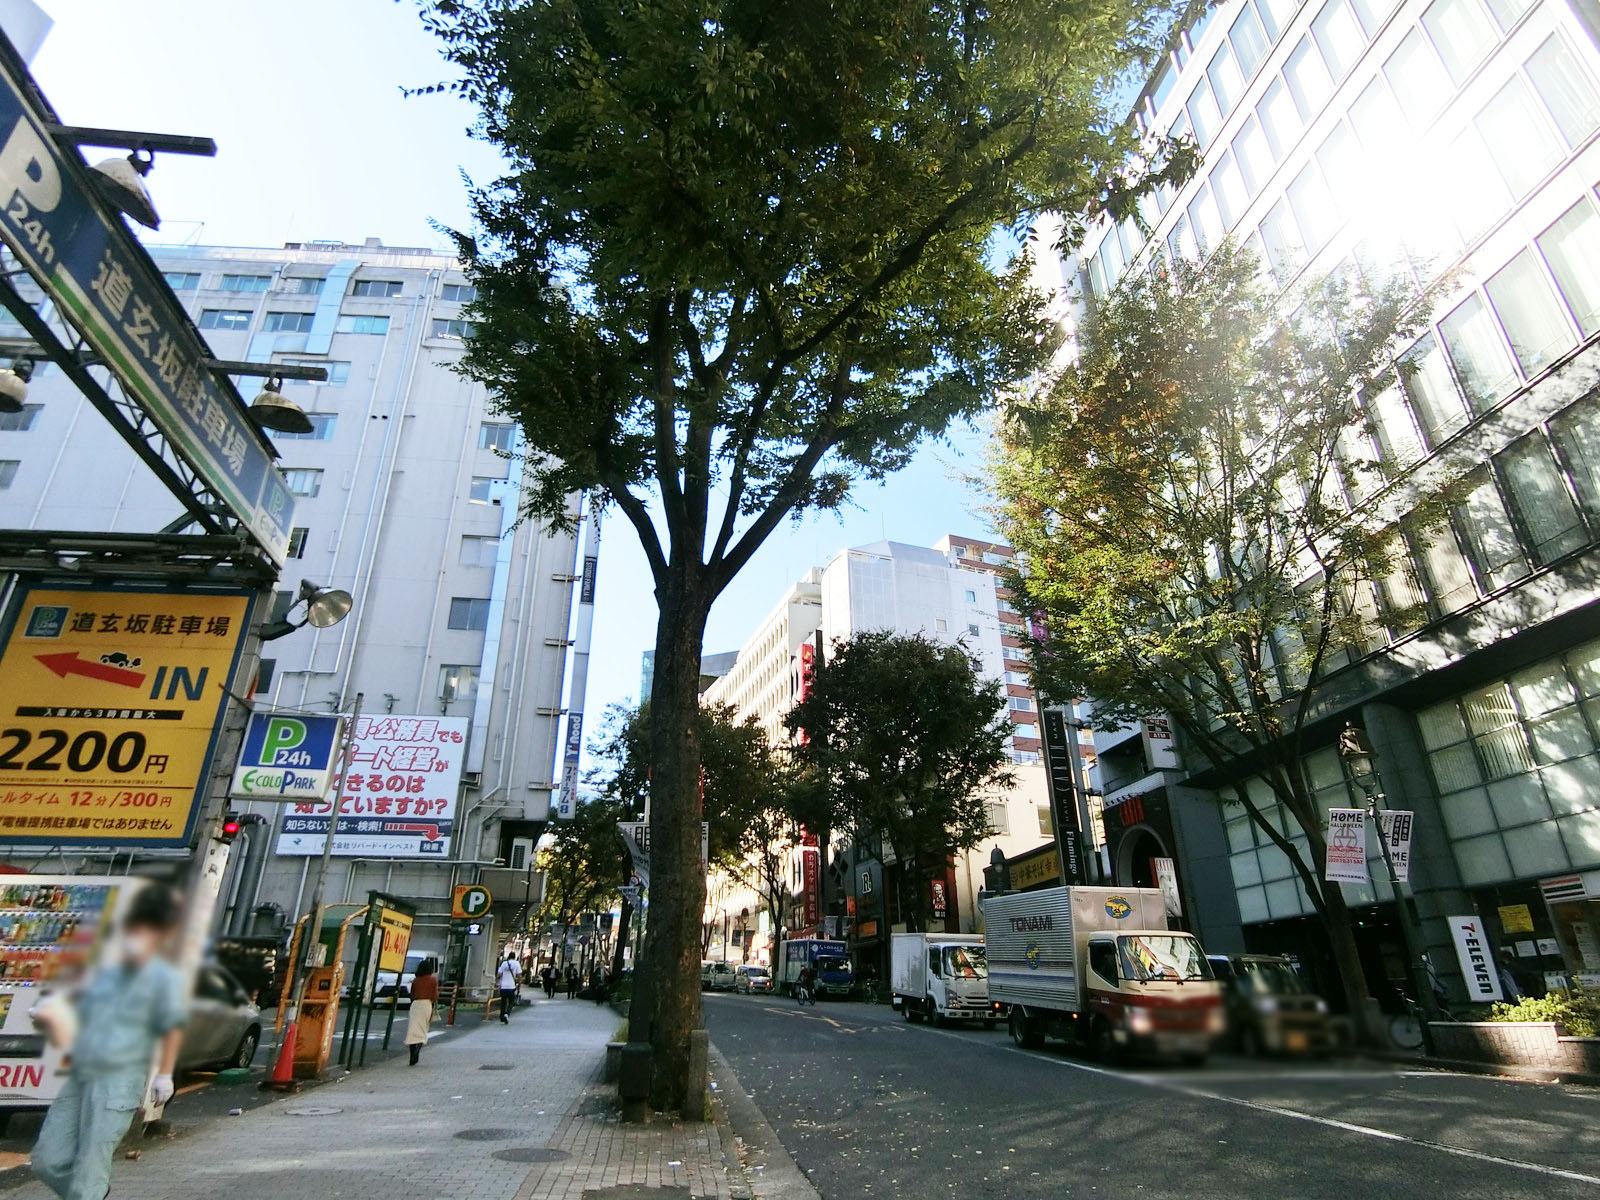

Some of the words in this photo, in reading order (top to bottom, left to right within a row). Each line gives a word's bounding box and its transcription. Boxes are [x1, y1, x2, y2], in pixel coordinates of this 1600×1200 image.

[0, 115, 62, 213] P
[8, 194, 55, 264] 24h
[92, 249, 249, 477] 道玄坂駐車場
[69, 612, 231, 637] 道玄坂駐車場
[149, 666, 209, 700] IN
[259, 717, 307, 766] P
[276, 750, 311, 766] 24h
[0, 815, 173, 831] 電機提携駐車場ではありません
[1066, 831, 1078, 875] Flamingo
[468, 892, 486, 912] P
[1009, 914, 1053, 932] TONAMI
